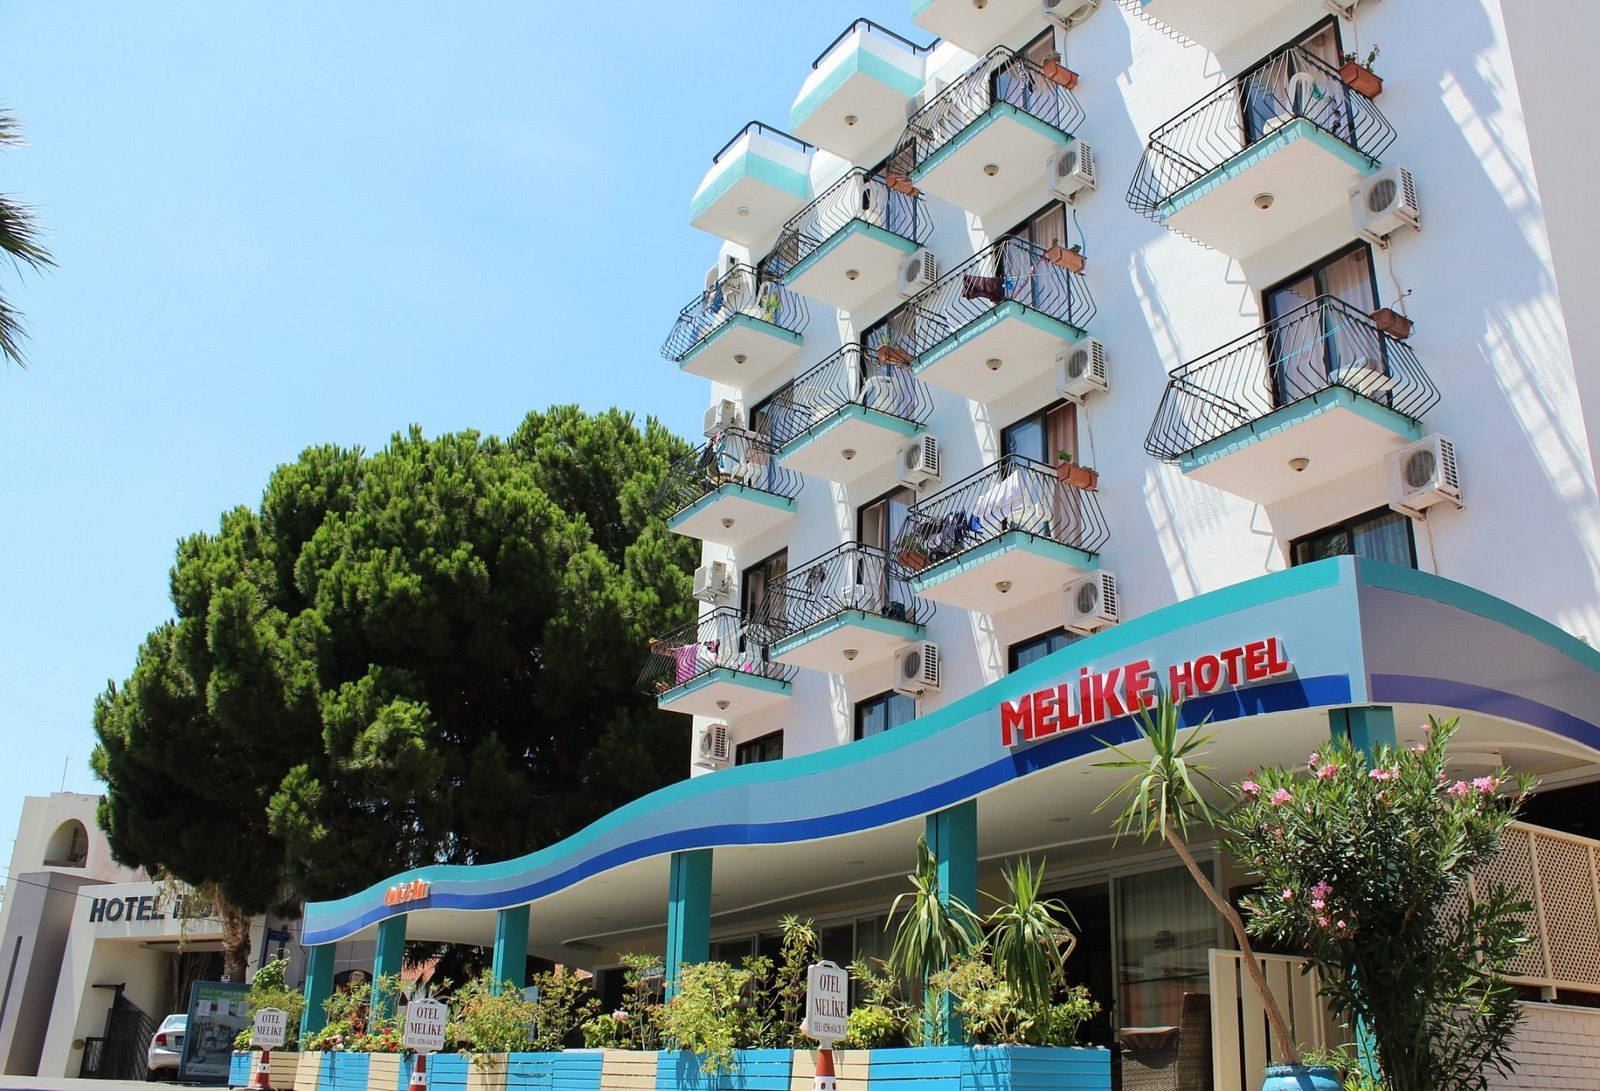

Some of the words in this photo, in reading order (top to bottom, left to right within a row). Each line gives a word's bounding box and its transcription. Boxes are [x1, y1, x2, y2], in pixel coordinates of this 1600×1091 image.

[1000, 659, 1158, 746] MELİKE
[1168, 636, 1292, 704] HOTEL
[89, 895, 165, 922] HOTEL
[819, 973, 841, 993] OTEL
[416, 1006, 440, 1020] OTEL
[814, 995, 846, 1019] MELİKE
[261, 1014, 281, 1024] OTEL
[409, 1021, 443, 1036] MELİKE
